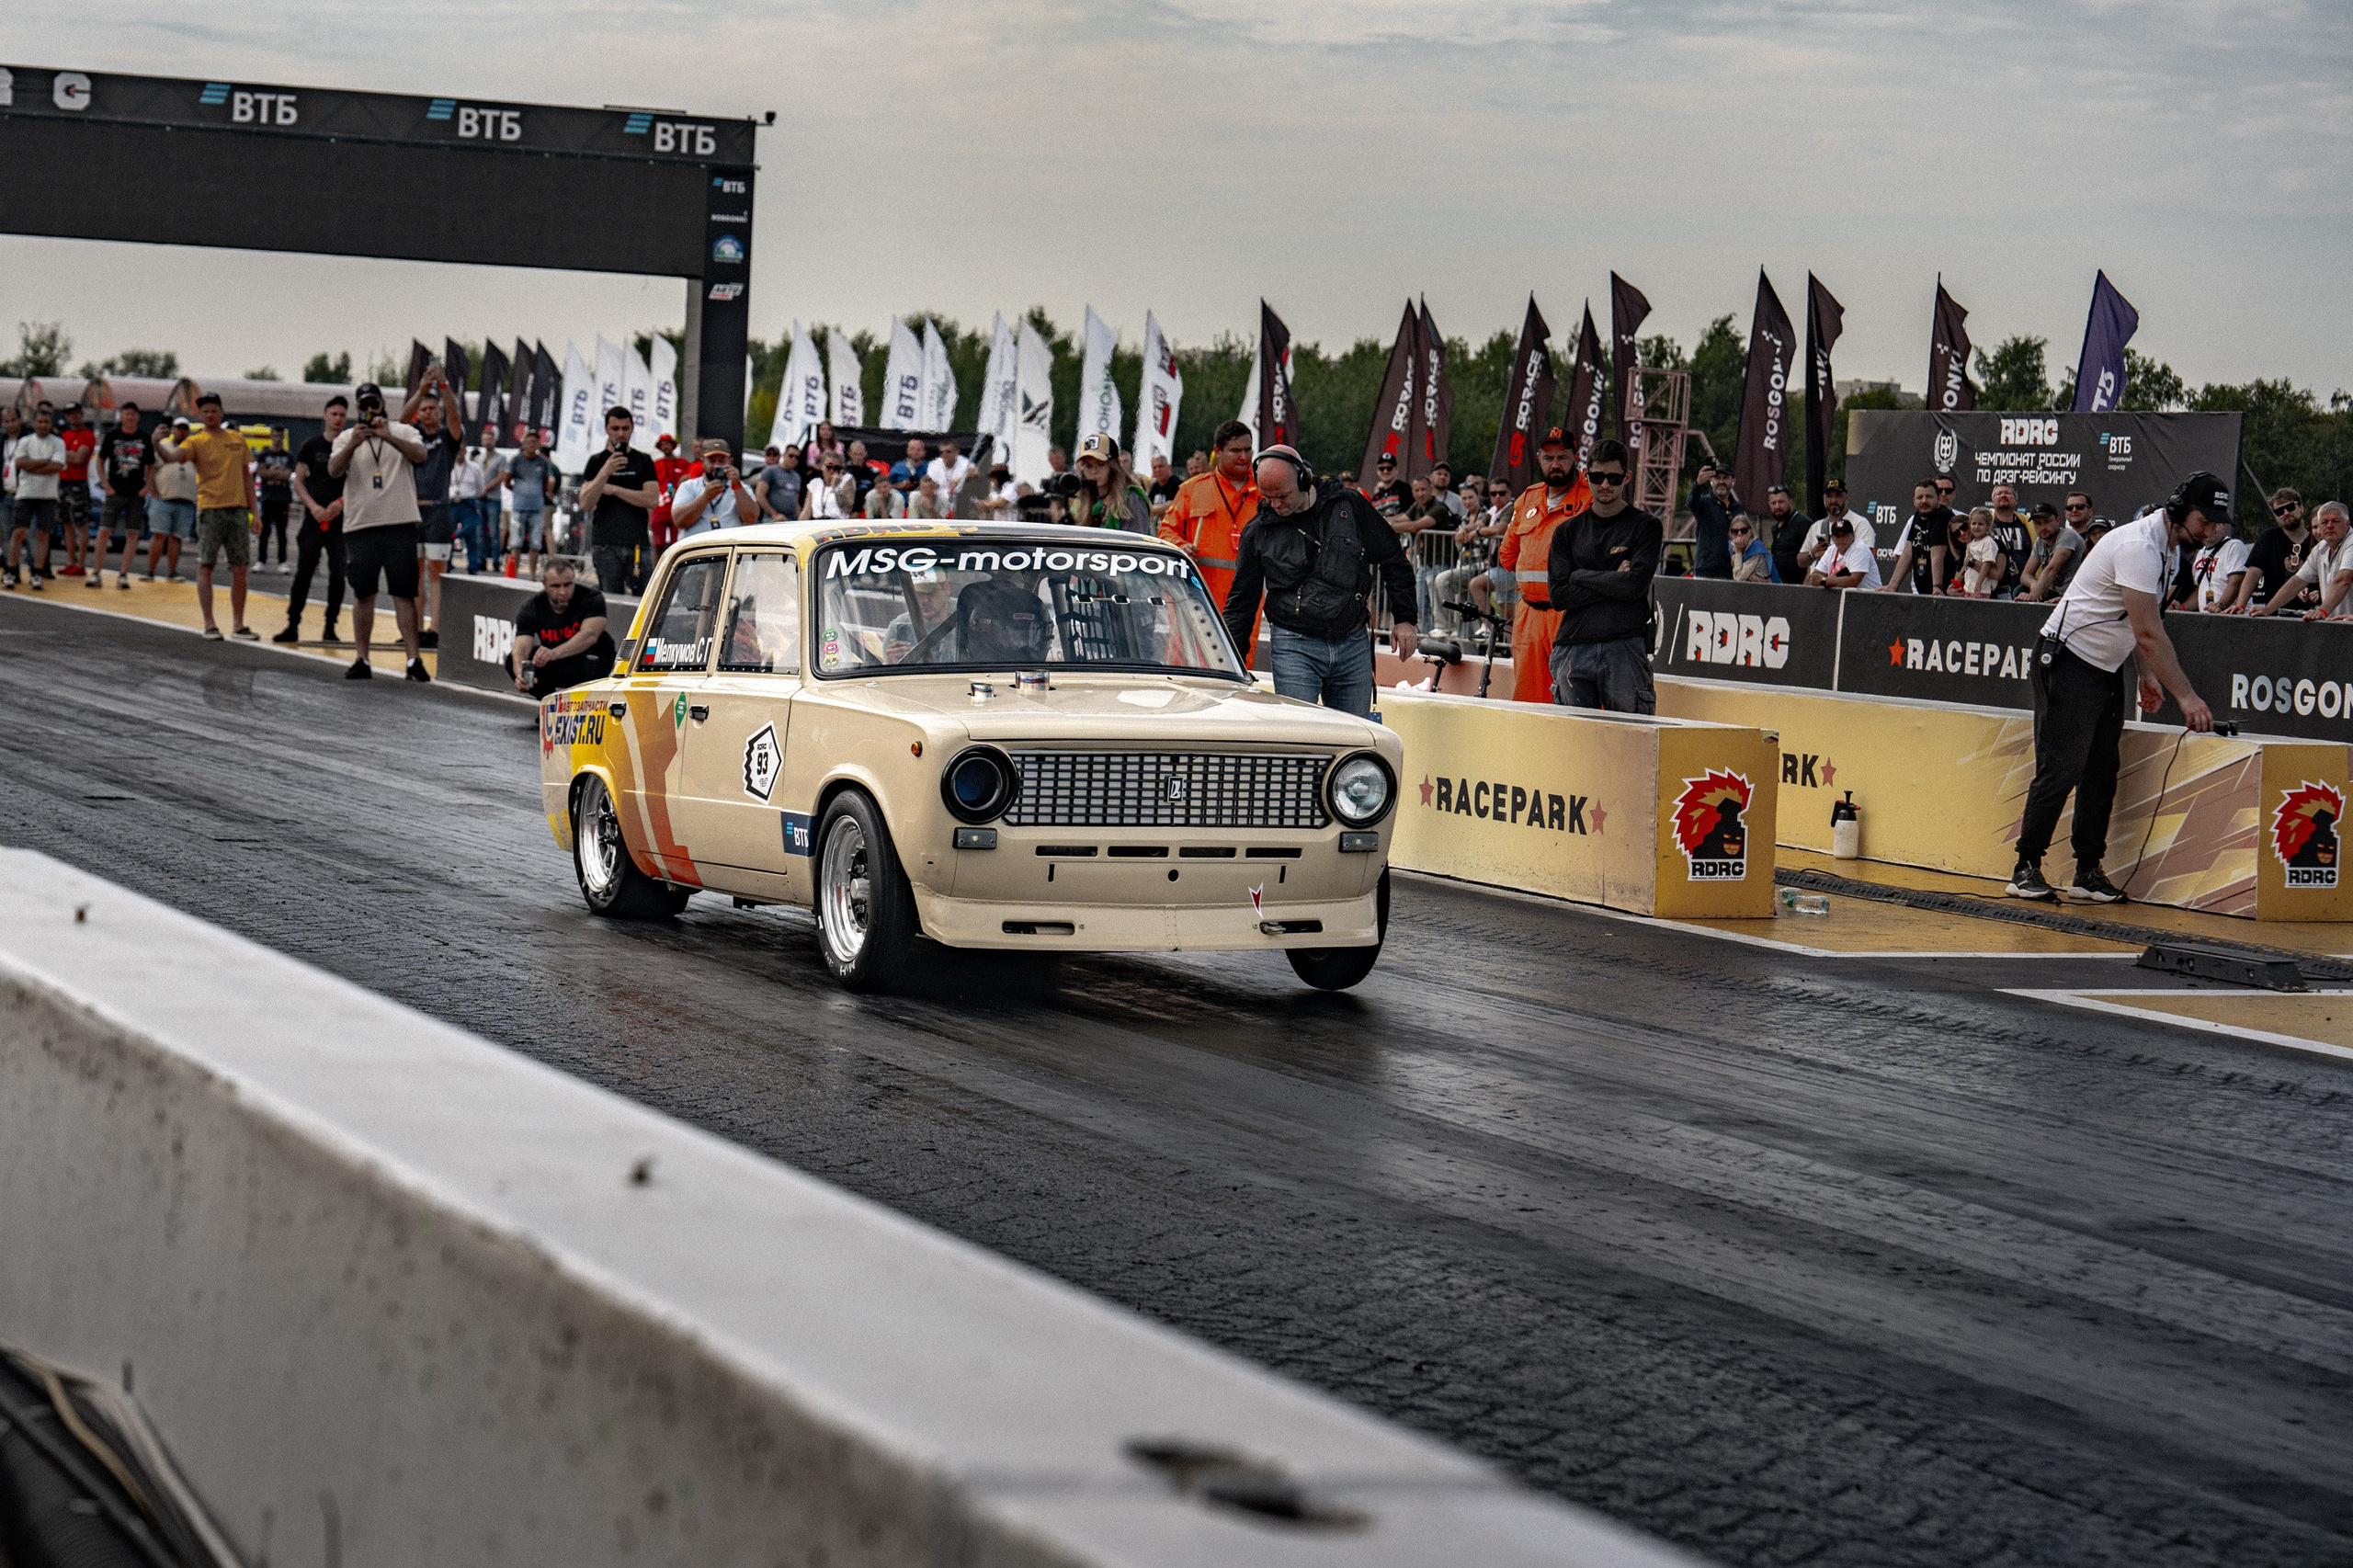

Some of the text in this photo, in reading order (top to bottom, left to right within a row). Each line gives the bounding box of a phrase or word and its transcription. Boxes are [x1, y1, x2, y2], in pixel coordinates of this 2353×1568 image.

[232, 91, 298, 126] ВТБ
[458, 107, 521, 142] ВТБ
[654, 122, 717, 155] ВТБ
[722, 180, 746, 194] ВТБ
[896, 374, 918, 419] ВТБ
[1516, 348, 1543, 430] GORACE
[2000, 418, 2059, 446] RDRC
[2109, 437, 2131, 454] ВТБ
[1975, 451, 2081, 468] ЧЕМПИОНАТ РОССИИ
[1976, 466, 2076, 485] ПО ДРЭГ-РЕЙСИНГУ
[1876, 506, 1897, 524] ВТБ
[825, 547, 1191, 580] MSG-motorsport
[473, 614, 517, 665] RDR
[654, 637, 697, 669] Мелкумов
[1686, 609, 1790, 670] RDRC
[562, 700, 608, 712] АВТОЗАПЧАСТИ
[554, 714, 606, 745] EXIST.RU
[756, 752, 768, 775] 93
[1437, 777, 1588, 835] RACEPARK
[793, 826, 809, 847] ВТБ
[1691, 861, 1745, 876] RDRC
[2288, 869, 2336, 883] RDRC
